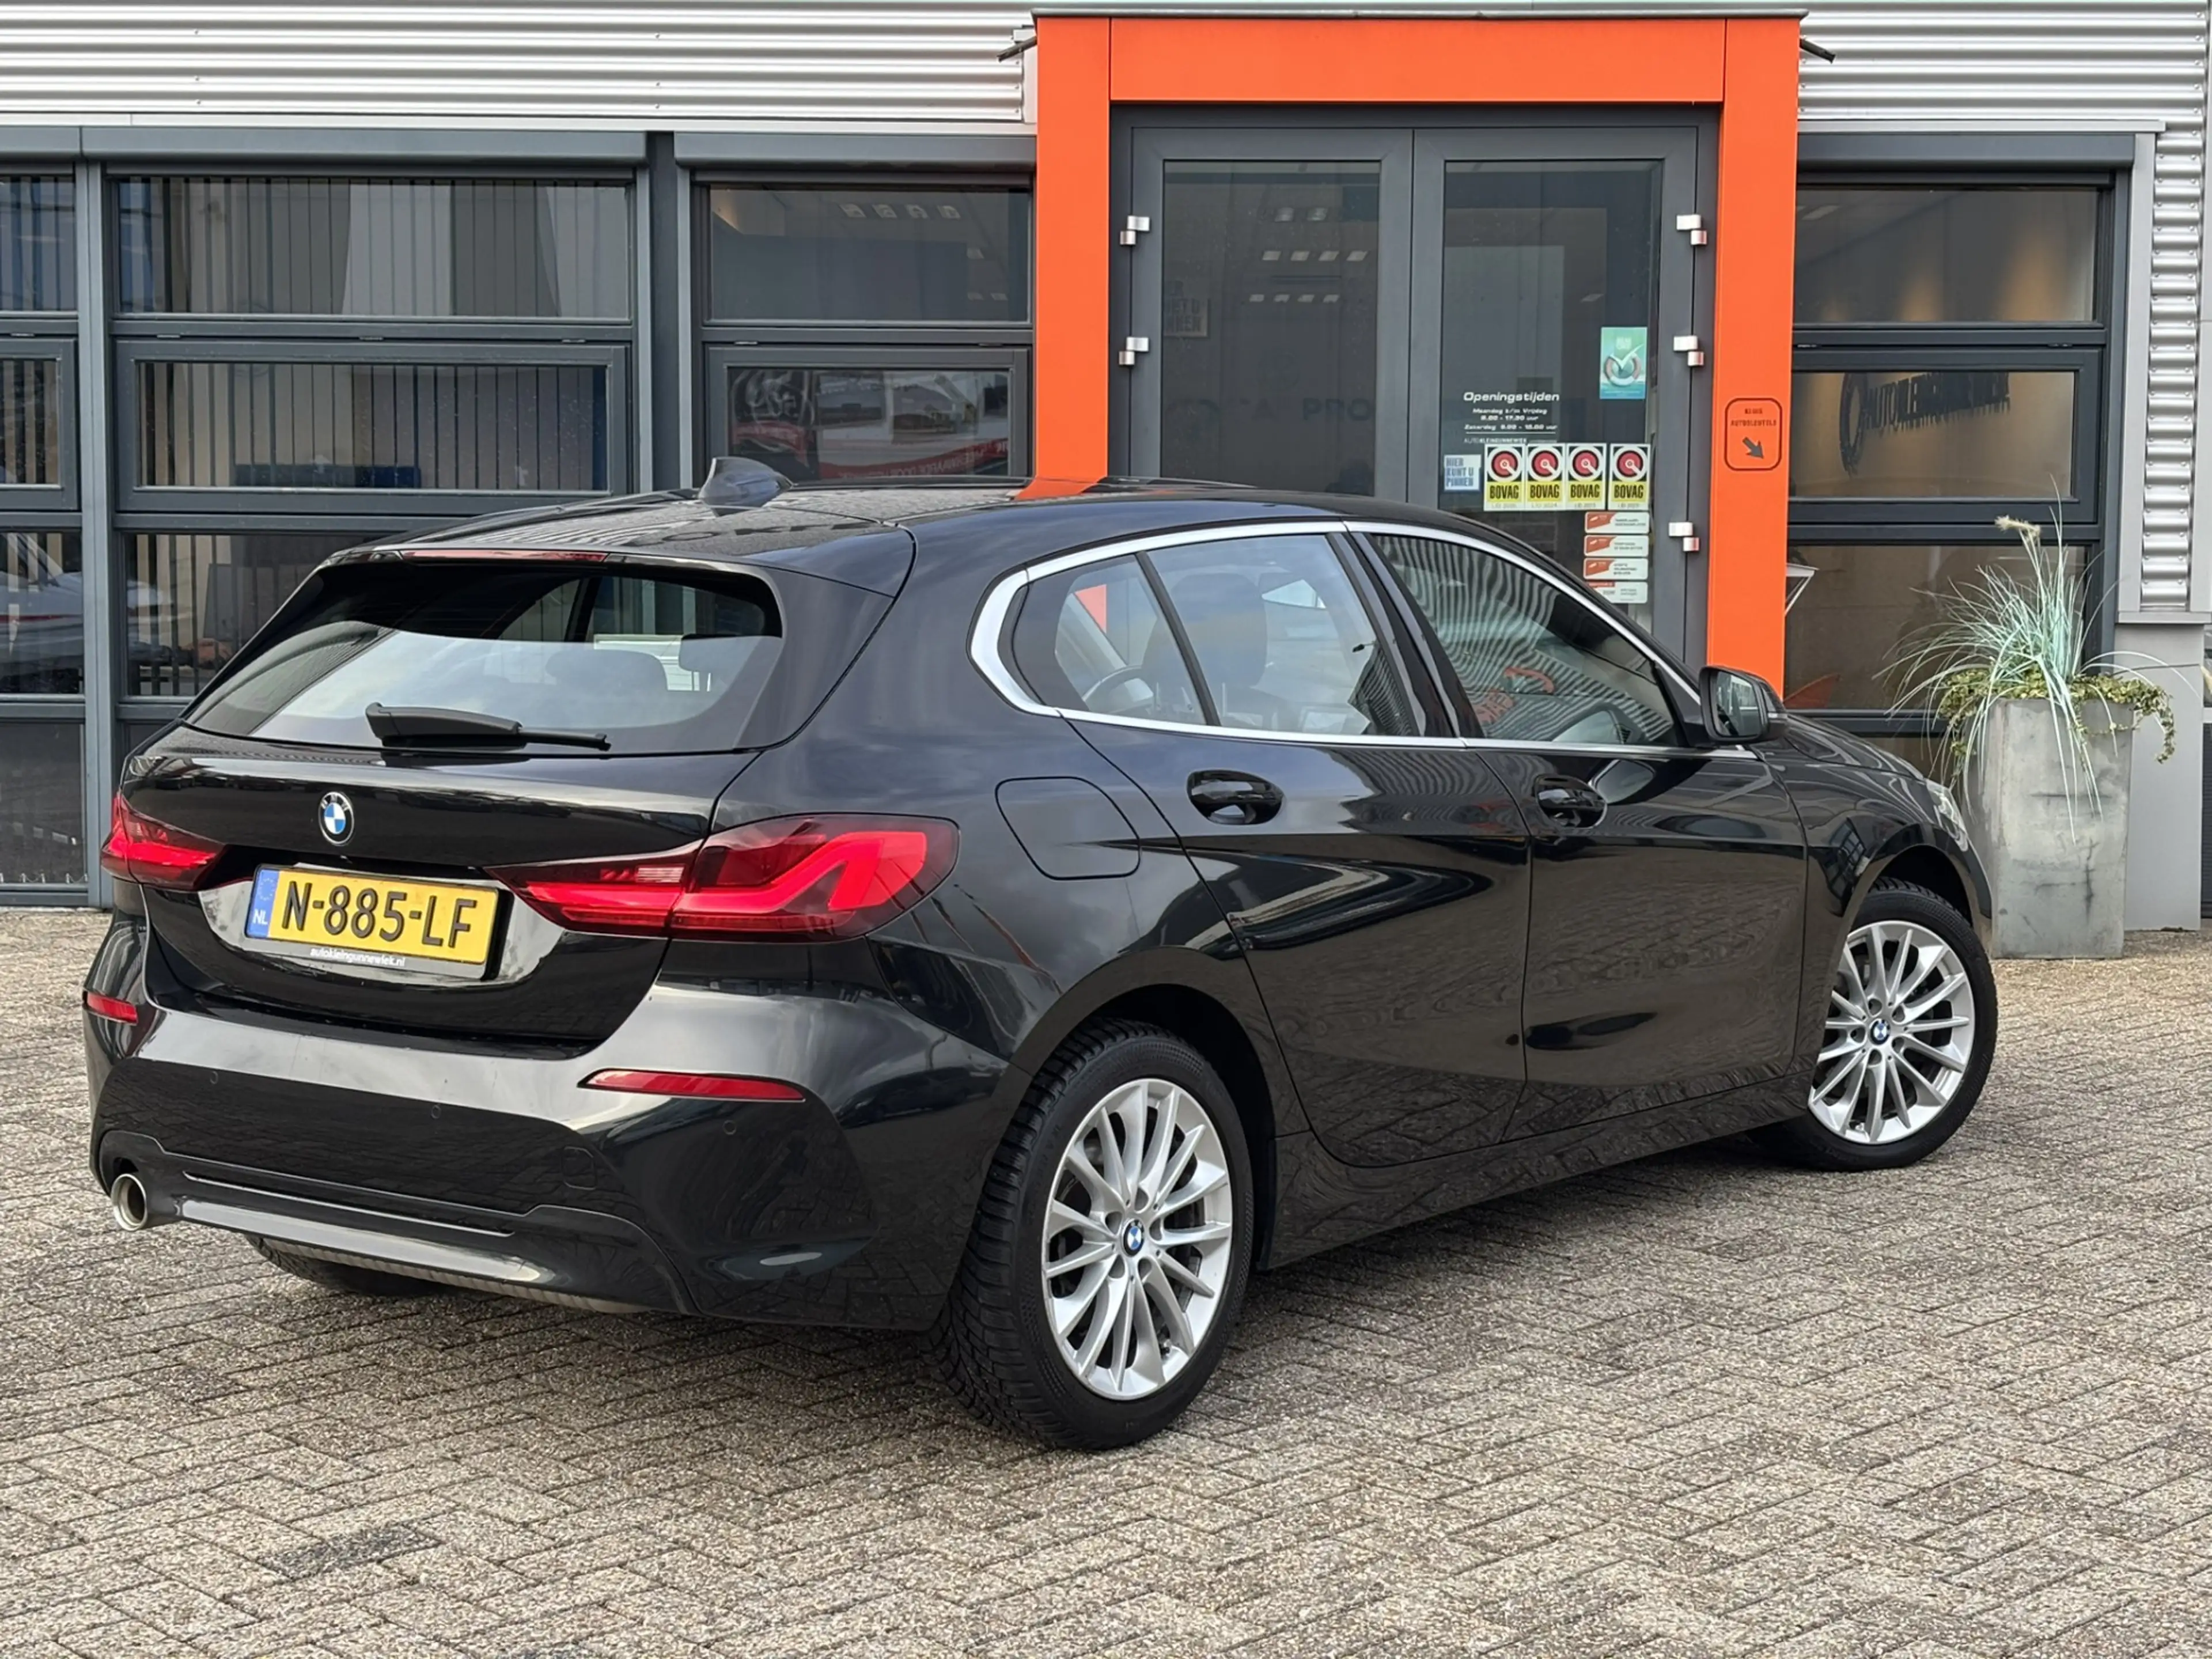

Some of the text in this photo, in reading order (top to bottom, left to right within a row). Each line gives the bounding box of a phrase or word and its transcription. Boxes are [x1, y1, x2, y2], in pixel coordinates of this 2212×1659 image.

[1463, 392, 1560, 404] Openingstijden
[1468, 467, 1474, 476] U
[1490, 485, 1519, 499] BOVAG
[1530, 484, 1559, 499] BOVAG
[1570, 484, 1600, 498] BOVAG
[1614, 484, 1643, 498] BOVAG
[253, 910, 268, 925] NL
[282, 881, 478, 948] N-885-LF
